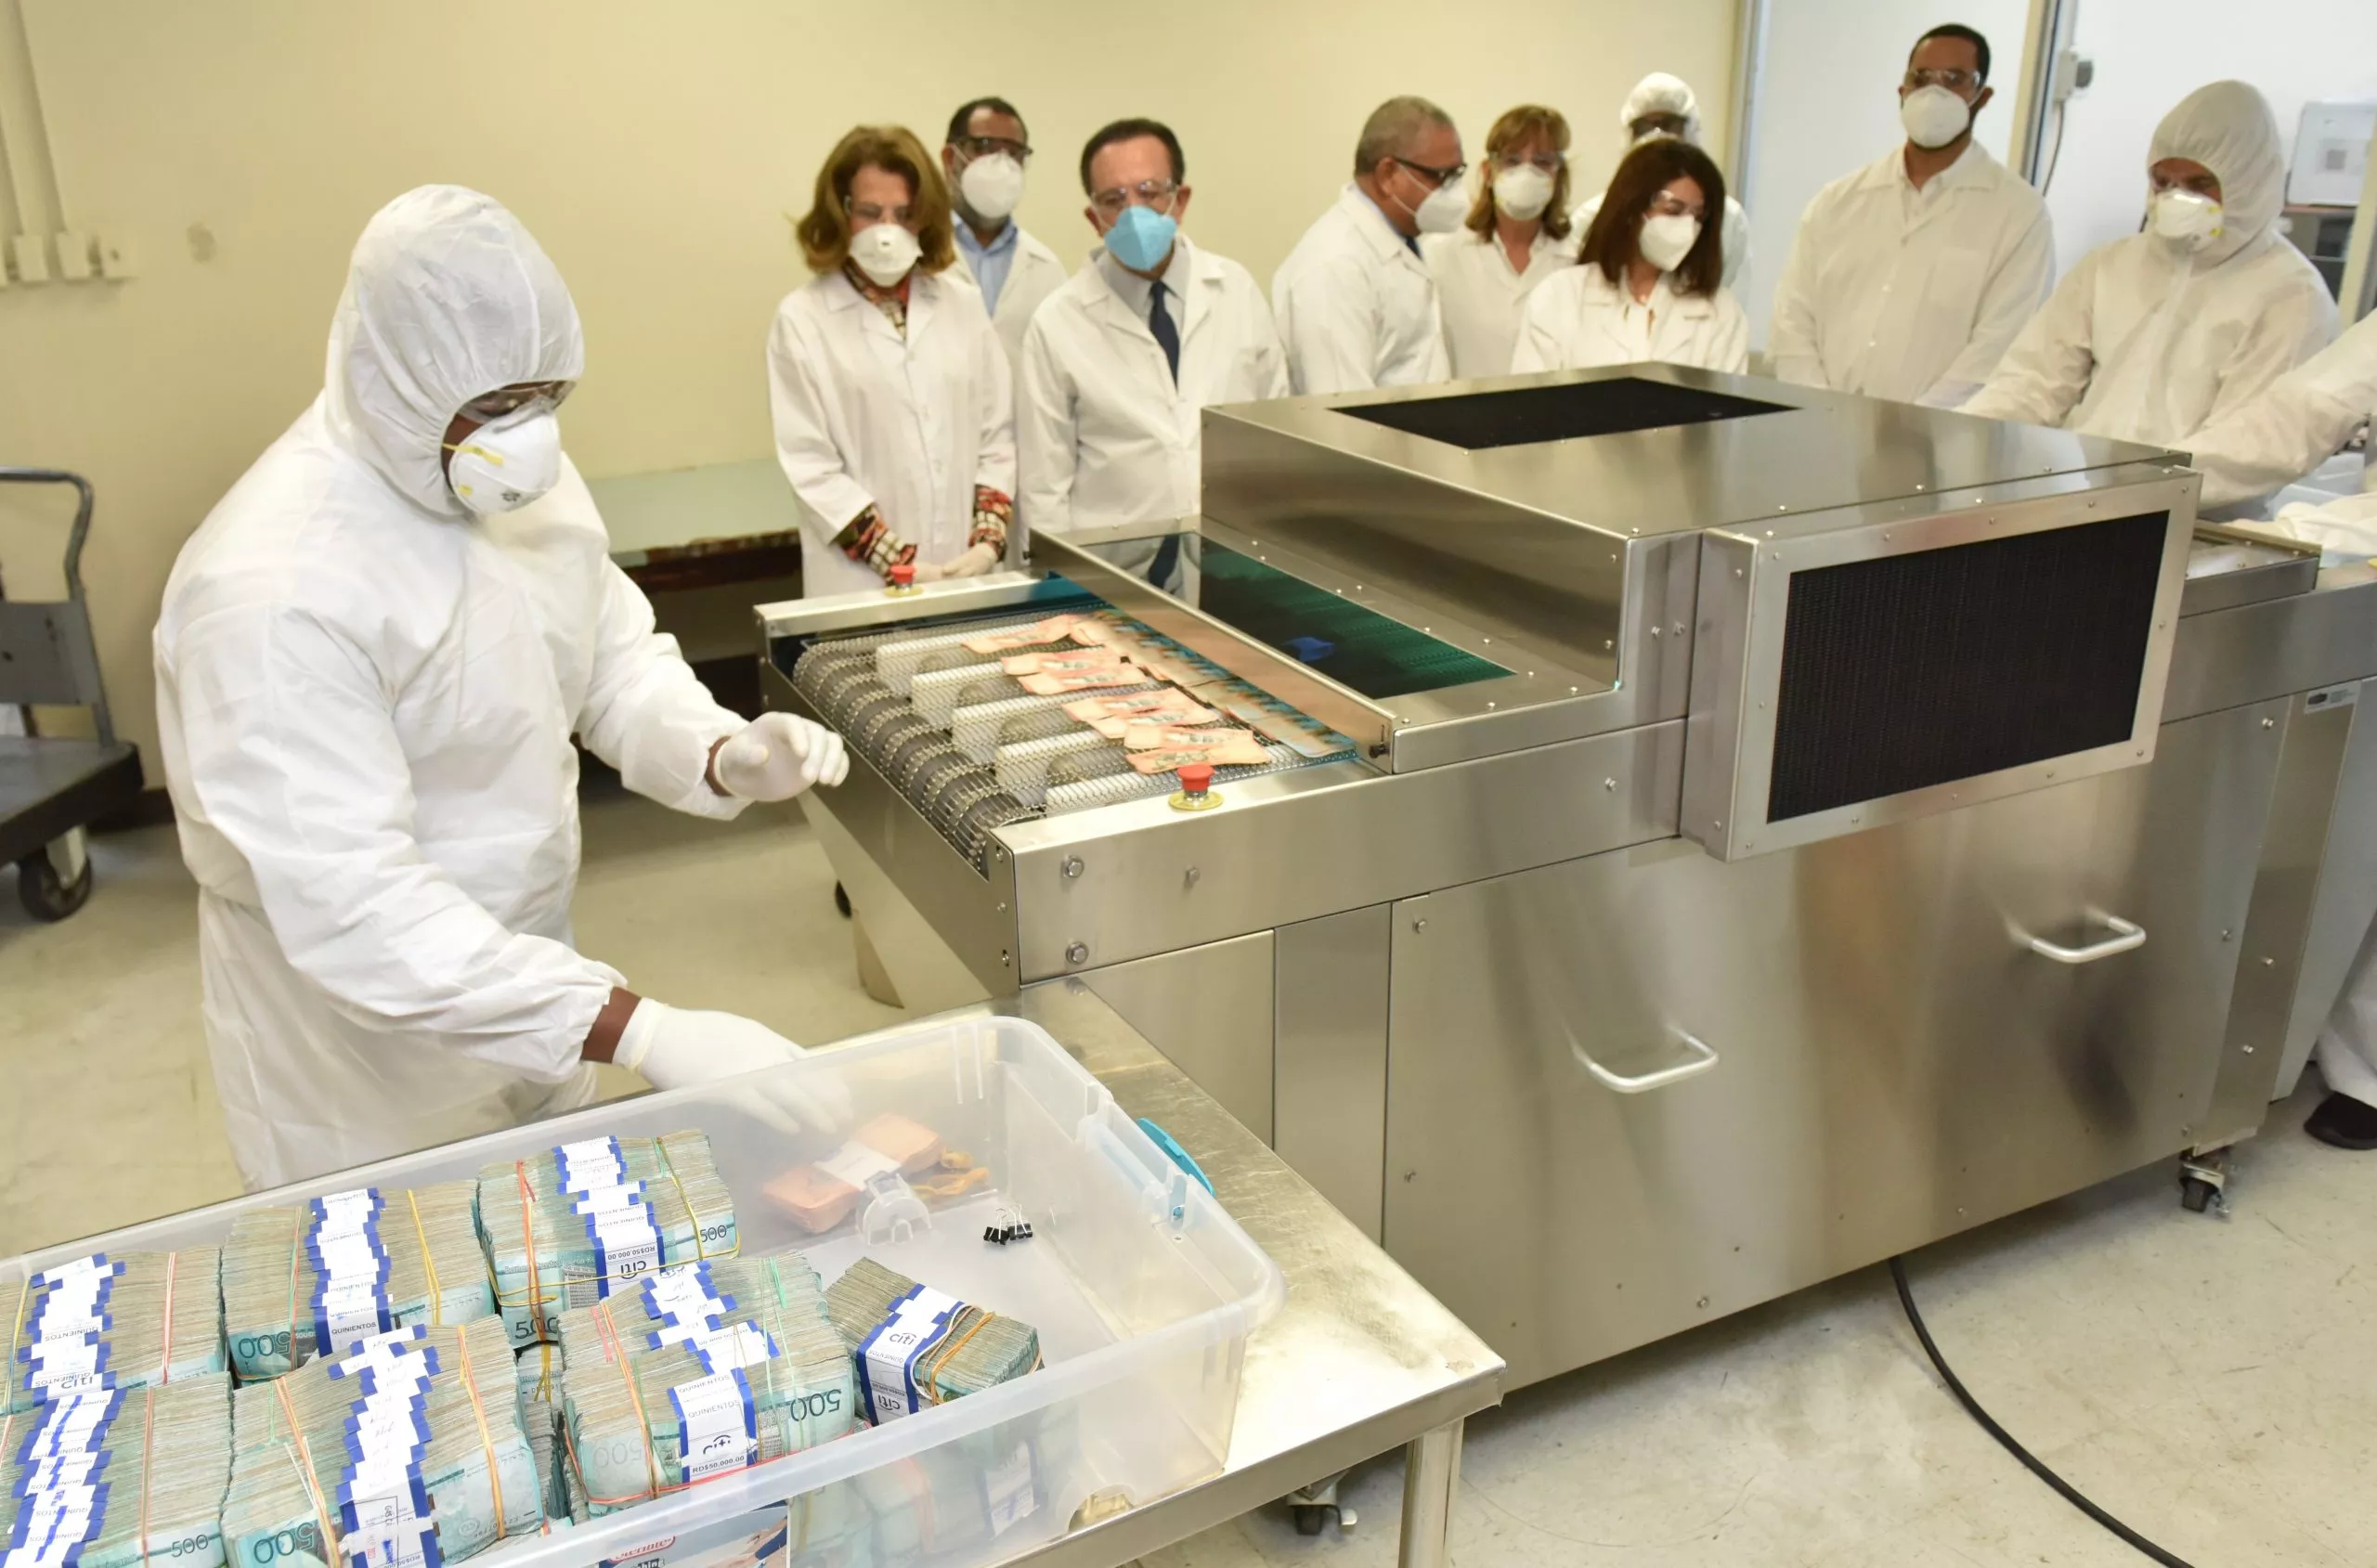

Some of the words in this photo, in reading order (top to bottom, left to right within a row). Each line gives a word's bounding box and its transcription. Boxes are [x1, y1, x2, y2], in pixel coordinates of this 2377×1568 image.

[699, 1225, 727, 1242] 500
[607, 1245, 656, 1260] RD$50,000.00
[44, 1326, 98, 1341] QUINIENTOS
[331, 1321, 377, 1335] QUINIENTOS
[238, 1331, 291, 1359] 500
[889, 1332, 917, 1345] citi
[868, 1350, 904, 1364] QUINIENTOS
[34, 1372, 91, 1386] QUINIENTOS
[678, 1374, 730, 1393] QUINIENTOS
[58, 1398, 109, 1409] QUINIEOS
[688, 1399, 740, 1419] QUINIENTOS
[789, 1389, 842, 1421] 500
[878, 1394, 901, 1411] citi
[32, 1446, 84, 1459] QUINITOS
[42, 1458, 93, 1470] QUINIEOS
[692, 1455, 745, 1473] RD$50,000.00
[30, 1479, 83, 1490] QUINITOS
[35, 1508, 88, 1517] QUINNTOS
[29, 1532, 83, 1542] QUINITOS
[253, 1522, 314, 1564] 500
[171, 1534, 209, 1558] 500
